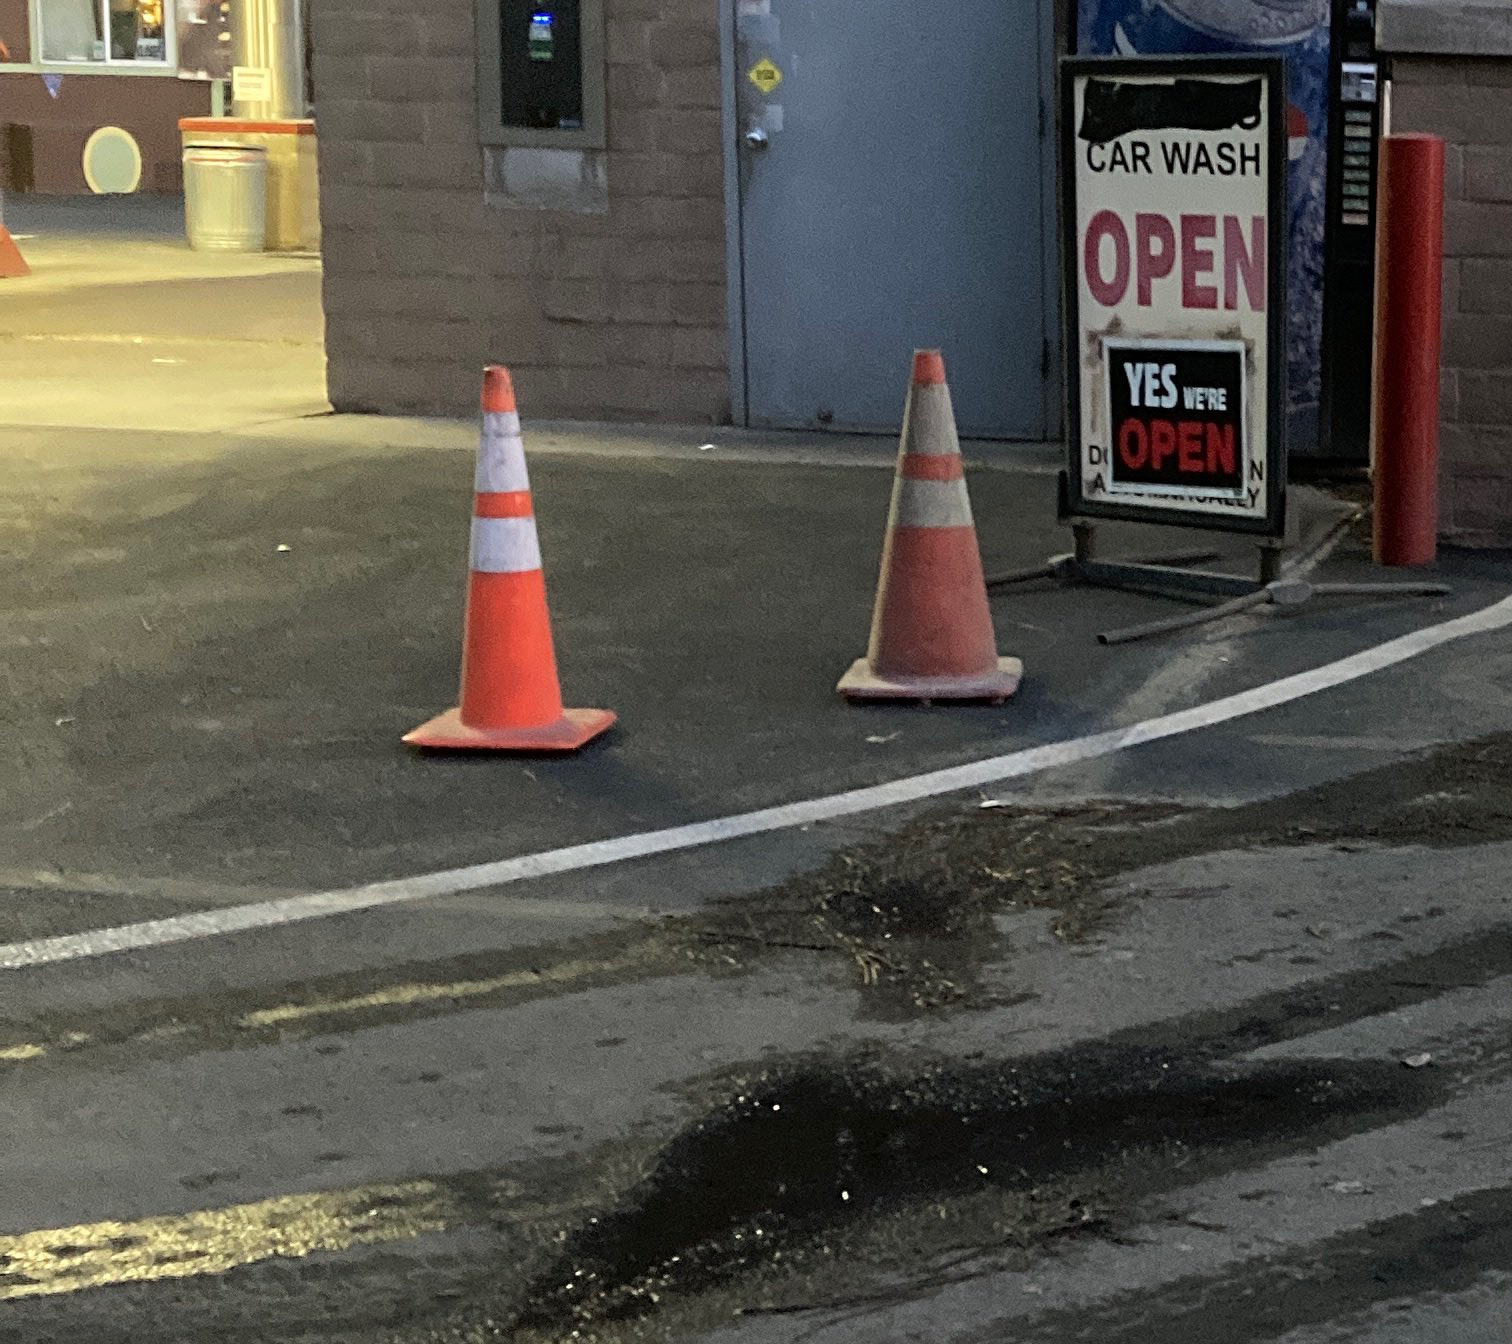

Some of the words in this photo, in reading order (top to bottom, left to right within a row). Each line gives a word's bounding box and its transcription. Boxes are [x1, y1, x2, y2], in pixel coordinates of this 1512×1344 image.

[1086, 141, 1152, 174] CAR
[1160, 141, 1260, 176] WASH
[1084, 209, 1264, 313] OPEN
[1123, 362, 1178, 408] YES
[1183, 386, 1228, 411] WE'RE
[1118, 417, 1237, 475] OPEN
